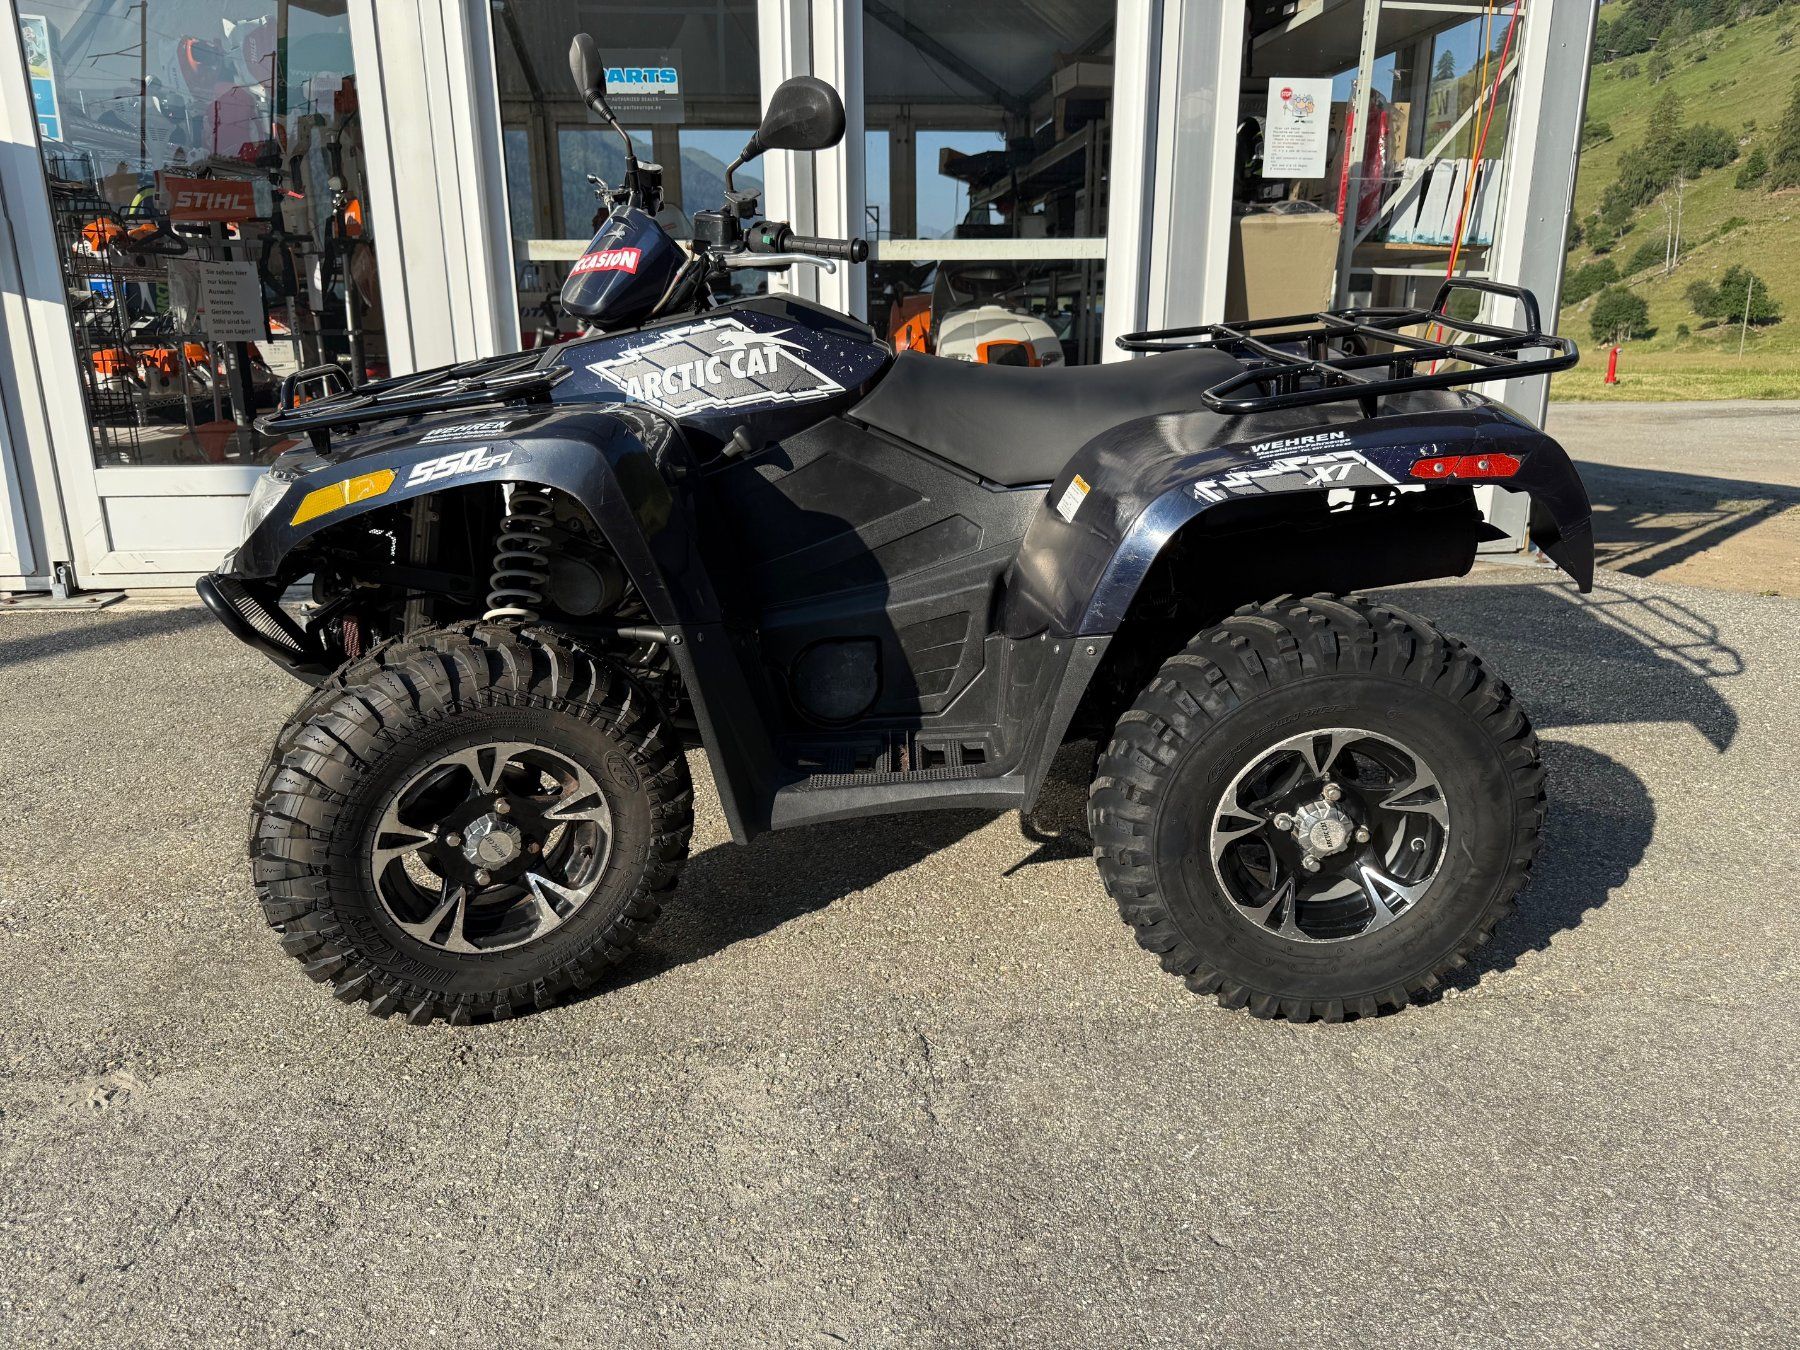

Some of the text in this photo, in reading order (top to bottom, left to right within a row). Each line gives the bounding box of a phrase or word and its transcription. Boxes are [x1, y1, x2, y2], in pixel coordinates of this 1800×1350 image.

[602, 67, 678, 84] ARTS
[176, 191, 248, 211] STIHL
[574, 250, 637, 273] CCASION
[626, 344, 781, 402] ARCTIC CAT
[1250, 431, 1345, 453] WEHREN
[1304, 462, 1360, 485] XT
